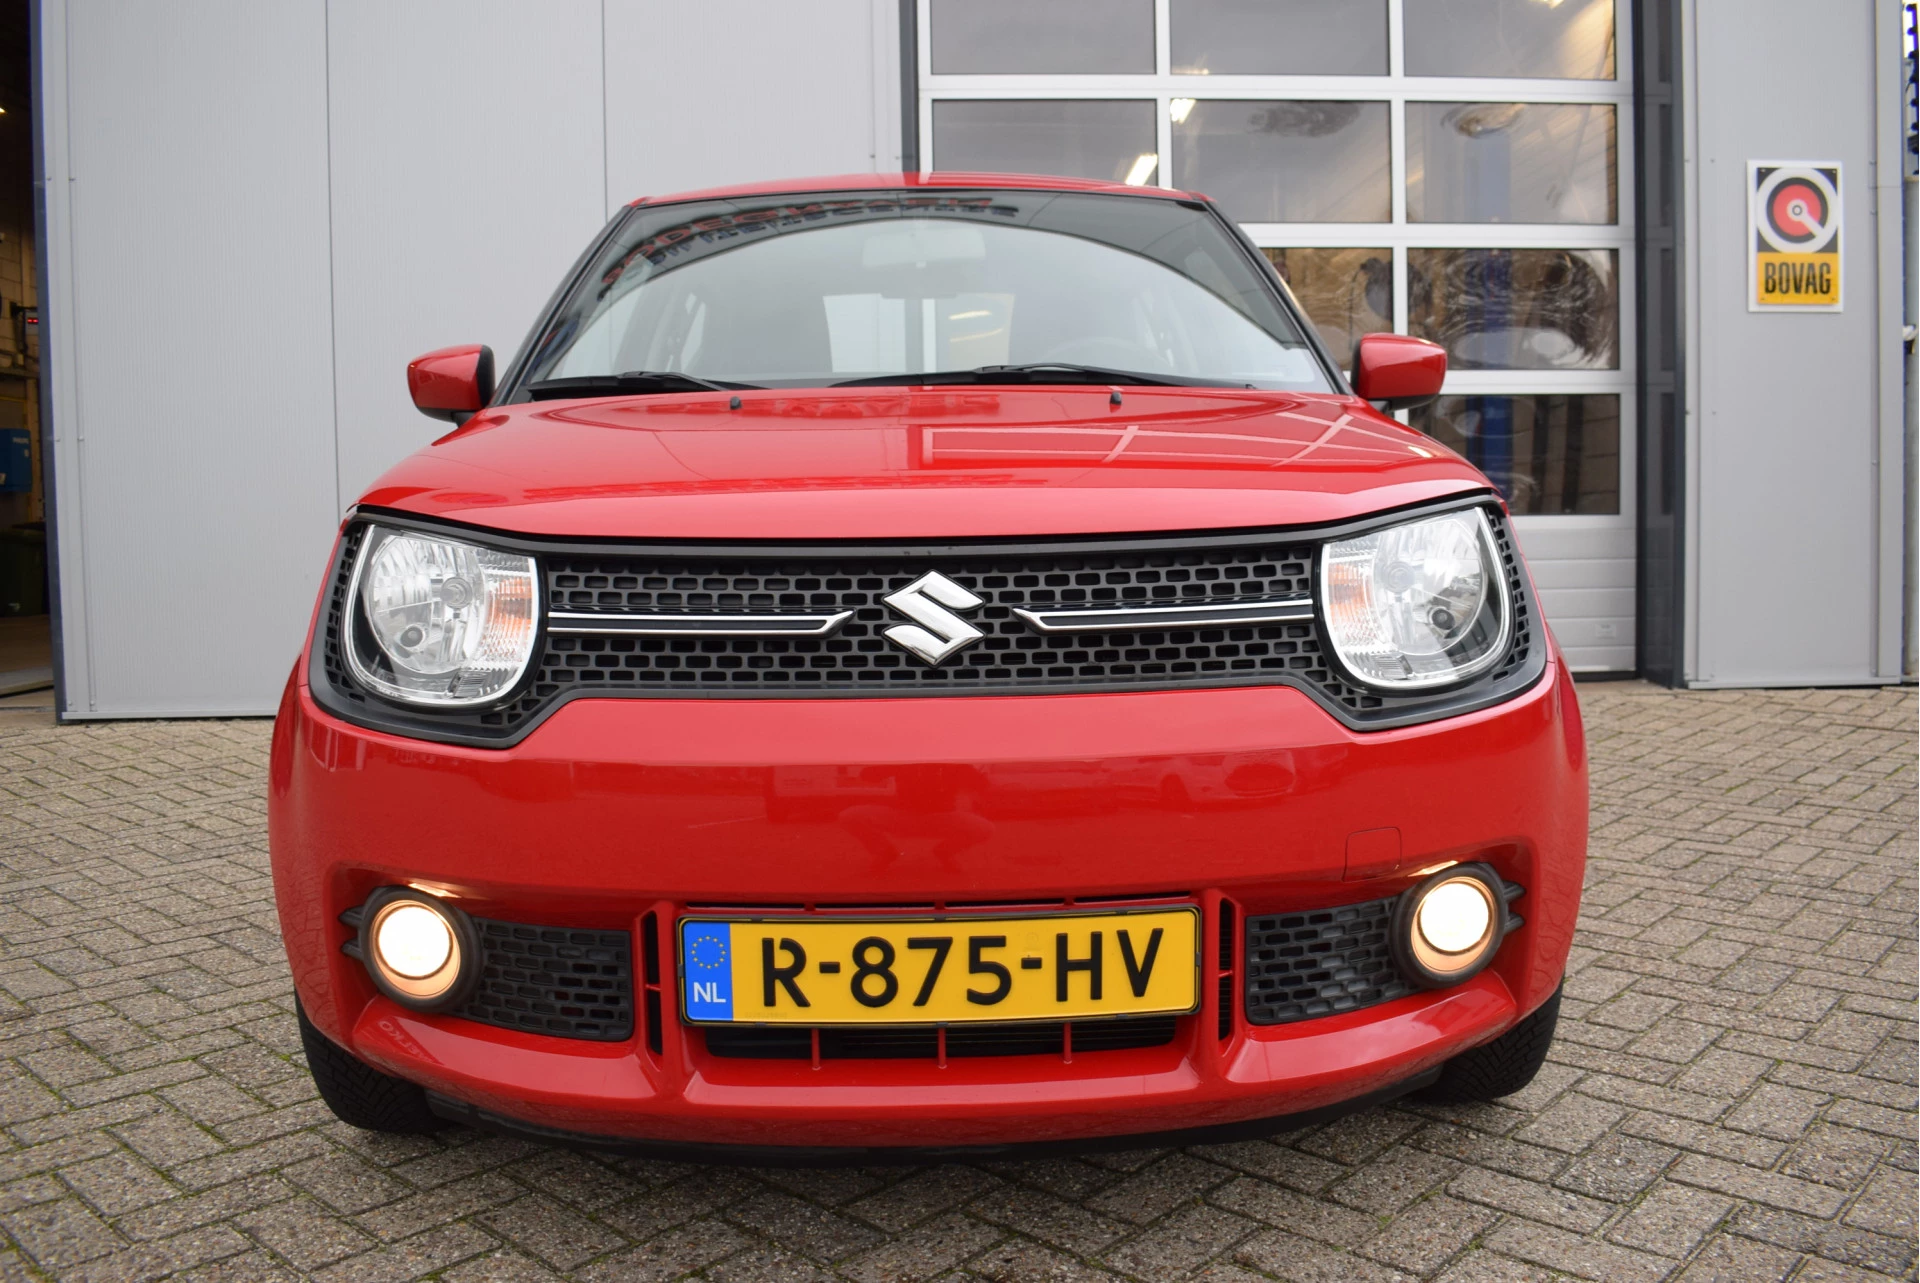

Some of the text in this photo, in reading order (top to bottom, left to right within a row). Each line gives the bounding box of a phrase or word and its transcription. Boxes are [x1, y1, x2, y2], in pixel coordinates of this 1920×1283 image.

[1764, 262, 1831, 294] BOVAG
[761, 927, 1164, 1008] R-875-HV
[693, 982, 727, 1003] NL
